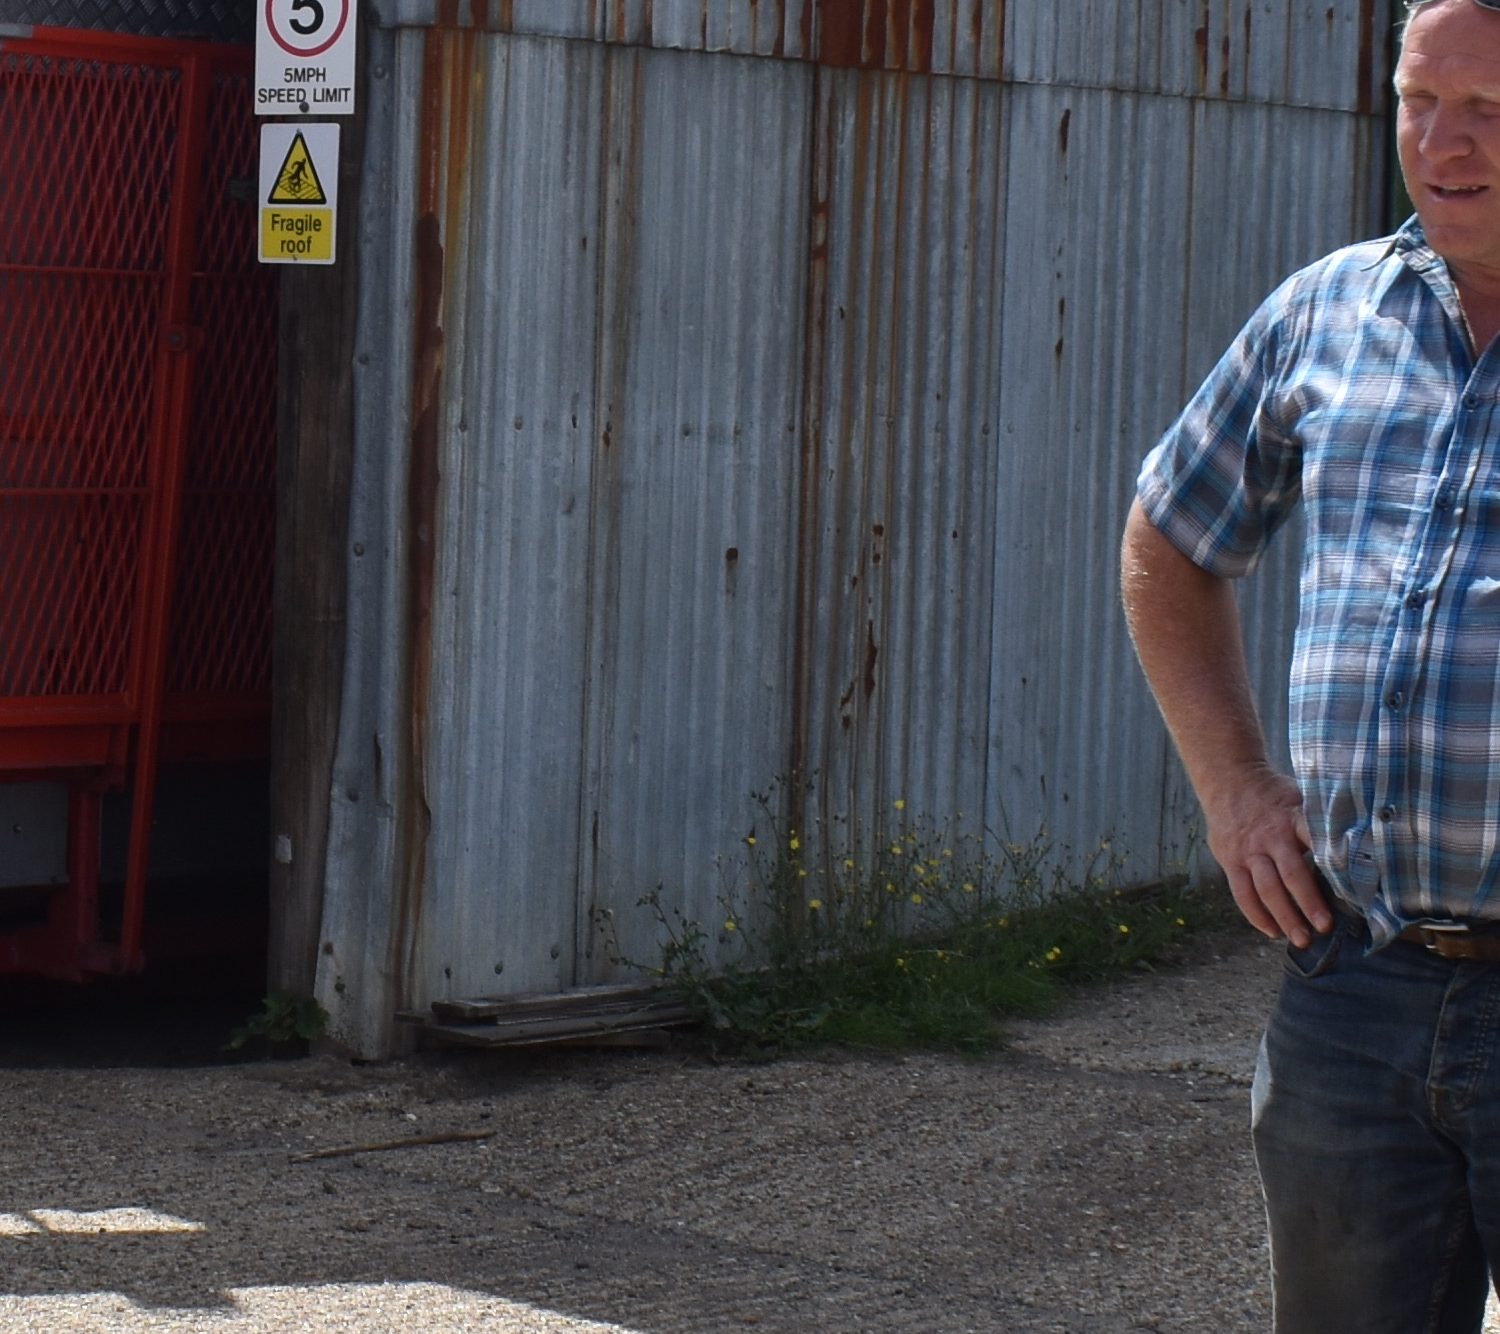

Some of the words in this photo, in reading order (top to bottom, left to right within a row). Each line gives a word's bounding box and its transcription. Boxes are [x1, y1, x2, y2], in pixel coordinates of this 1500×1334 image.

[283, 66, 326, 83] 5MPH
[257, 87, 307, 104] SPEED
[313, 87, 351, 103] LIMIT
[271, 213, 322, 235] Fragile
[280, 235, 312, 253] roof
